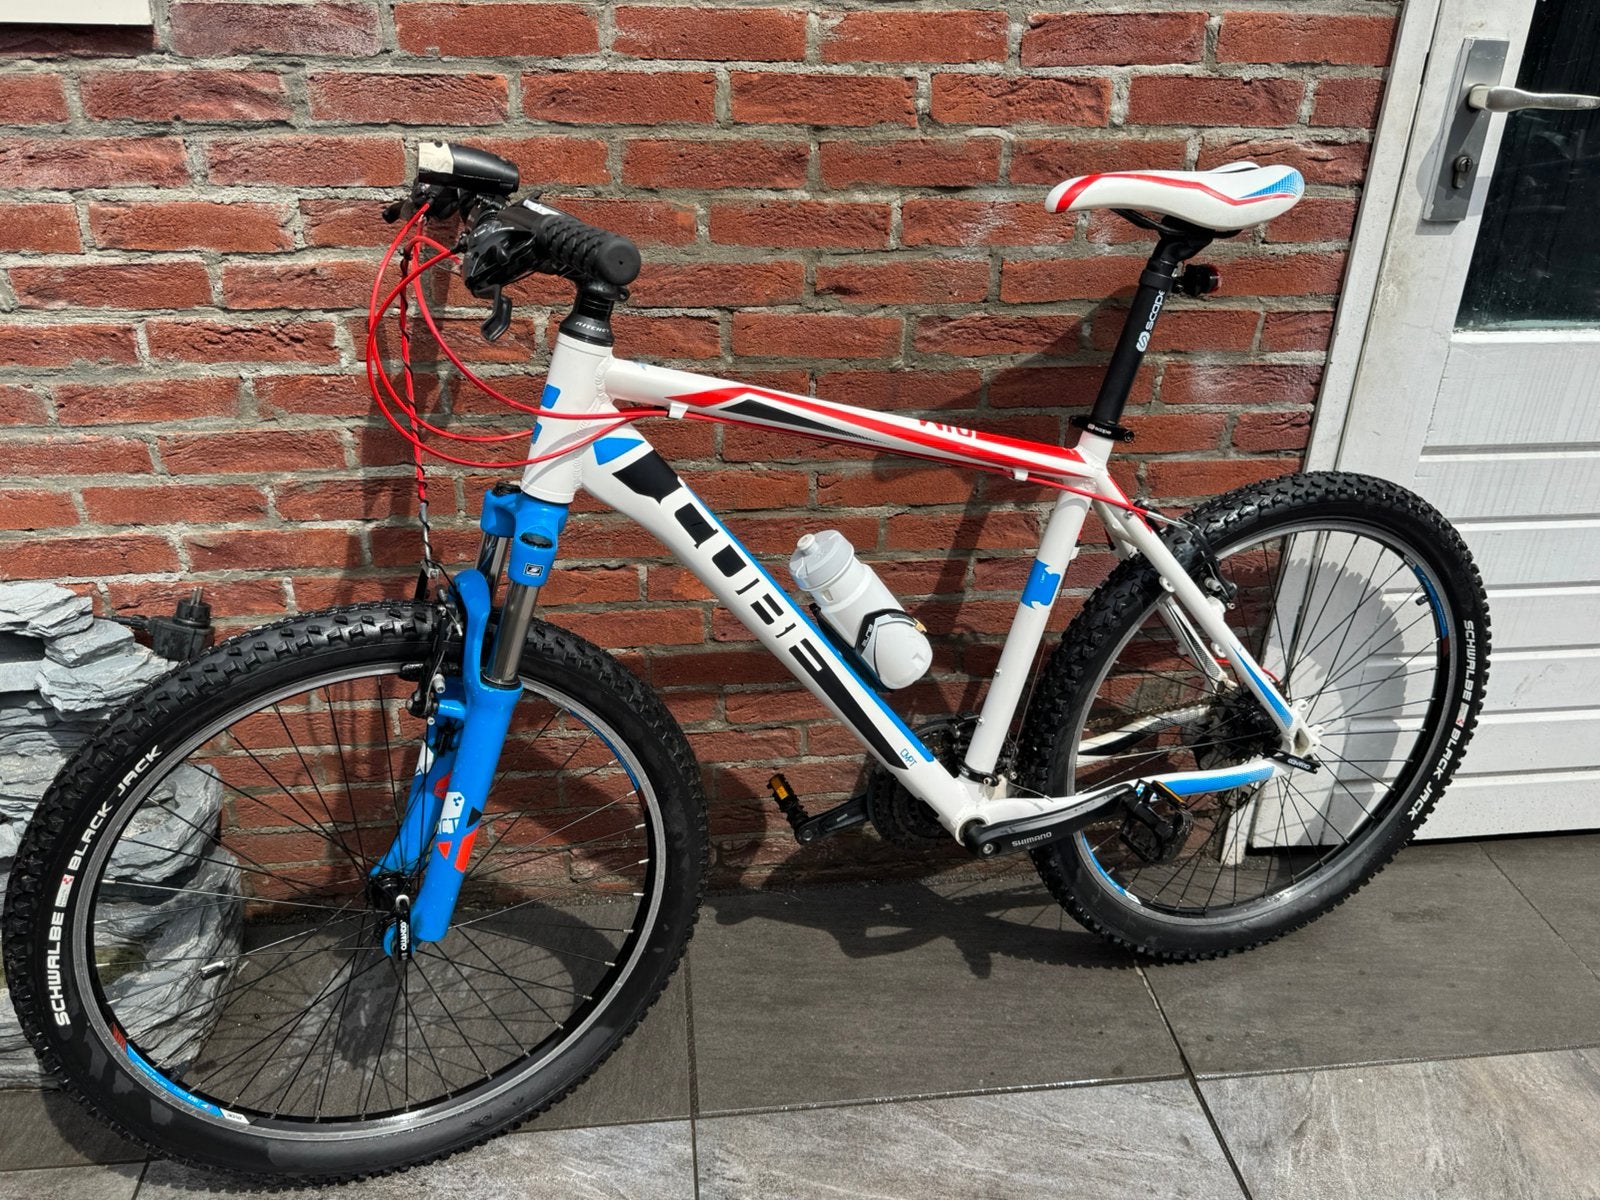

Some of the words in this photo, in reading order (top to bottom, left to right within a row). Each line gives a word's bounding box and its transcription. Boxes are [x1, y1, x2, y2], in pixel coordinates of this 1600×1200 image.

[1462, 619, 1477, 702] SCHWALBE
[899, 748, 918, 767] CMPT
[1432, 727, 1461, 781] BLACK
[1406, 781, 1433, 821] JACK
[1011, 831, 1052, 847] SHIMANO
[47, 912, 71, 1026] SCHWALBE
[67, 801, 113, 871] BLACK
[116, 745, 163, 796] JACK
